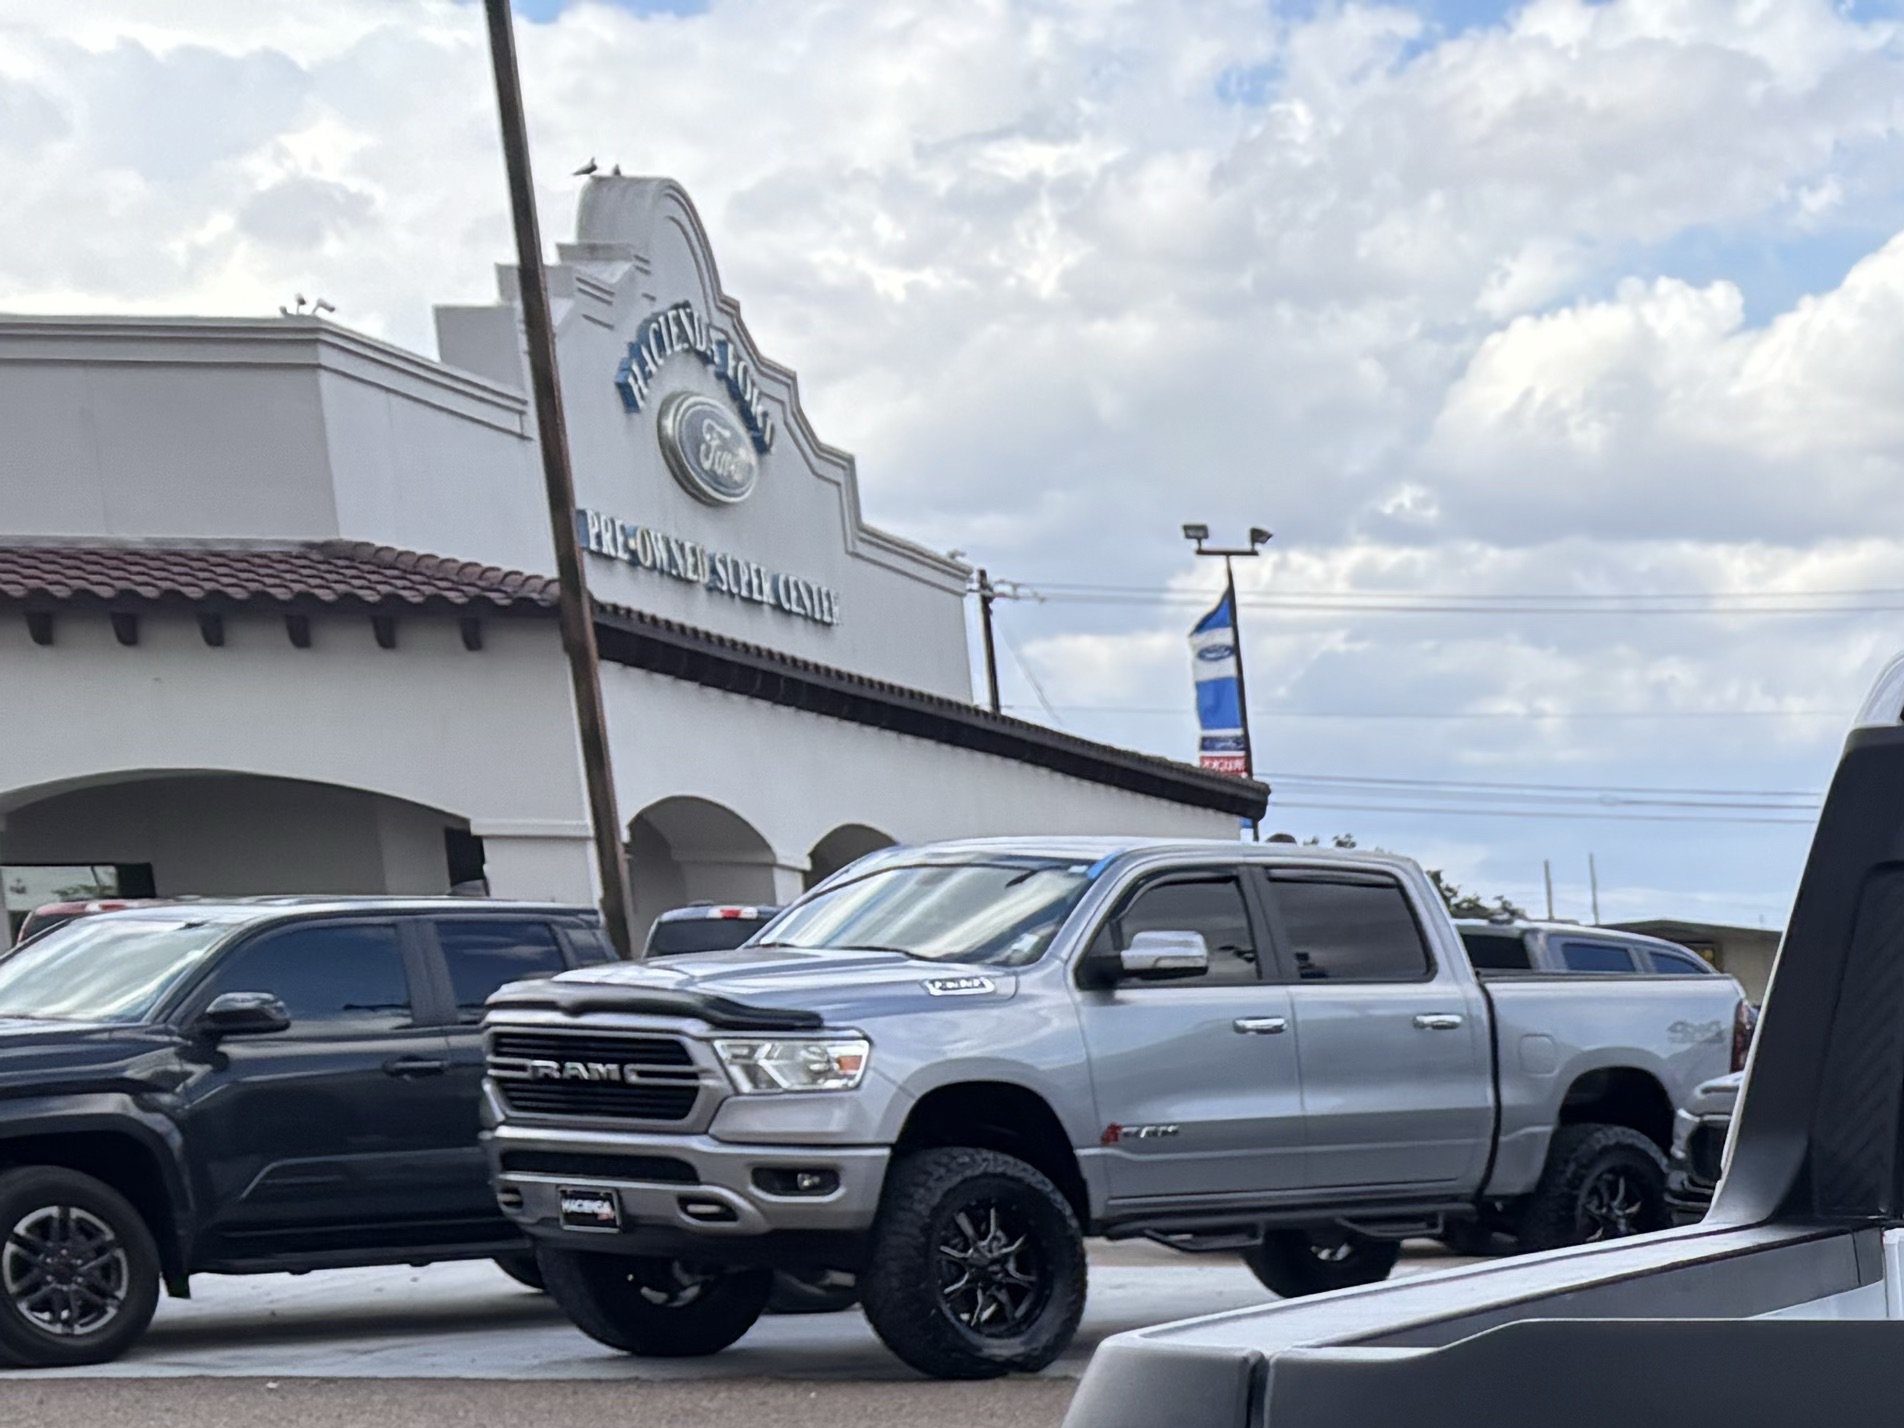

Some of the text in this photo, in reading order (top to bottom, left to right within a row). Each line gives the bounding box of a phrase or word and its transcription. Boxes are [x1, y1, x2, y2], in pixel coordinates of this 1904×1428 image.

[586, 510, 840, 625] PRE-OWNED SUPER CENTER
[531, 1060, 620, 1081] RAM
